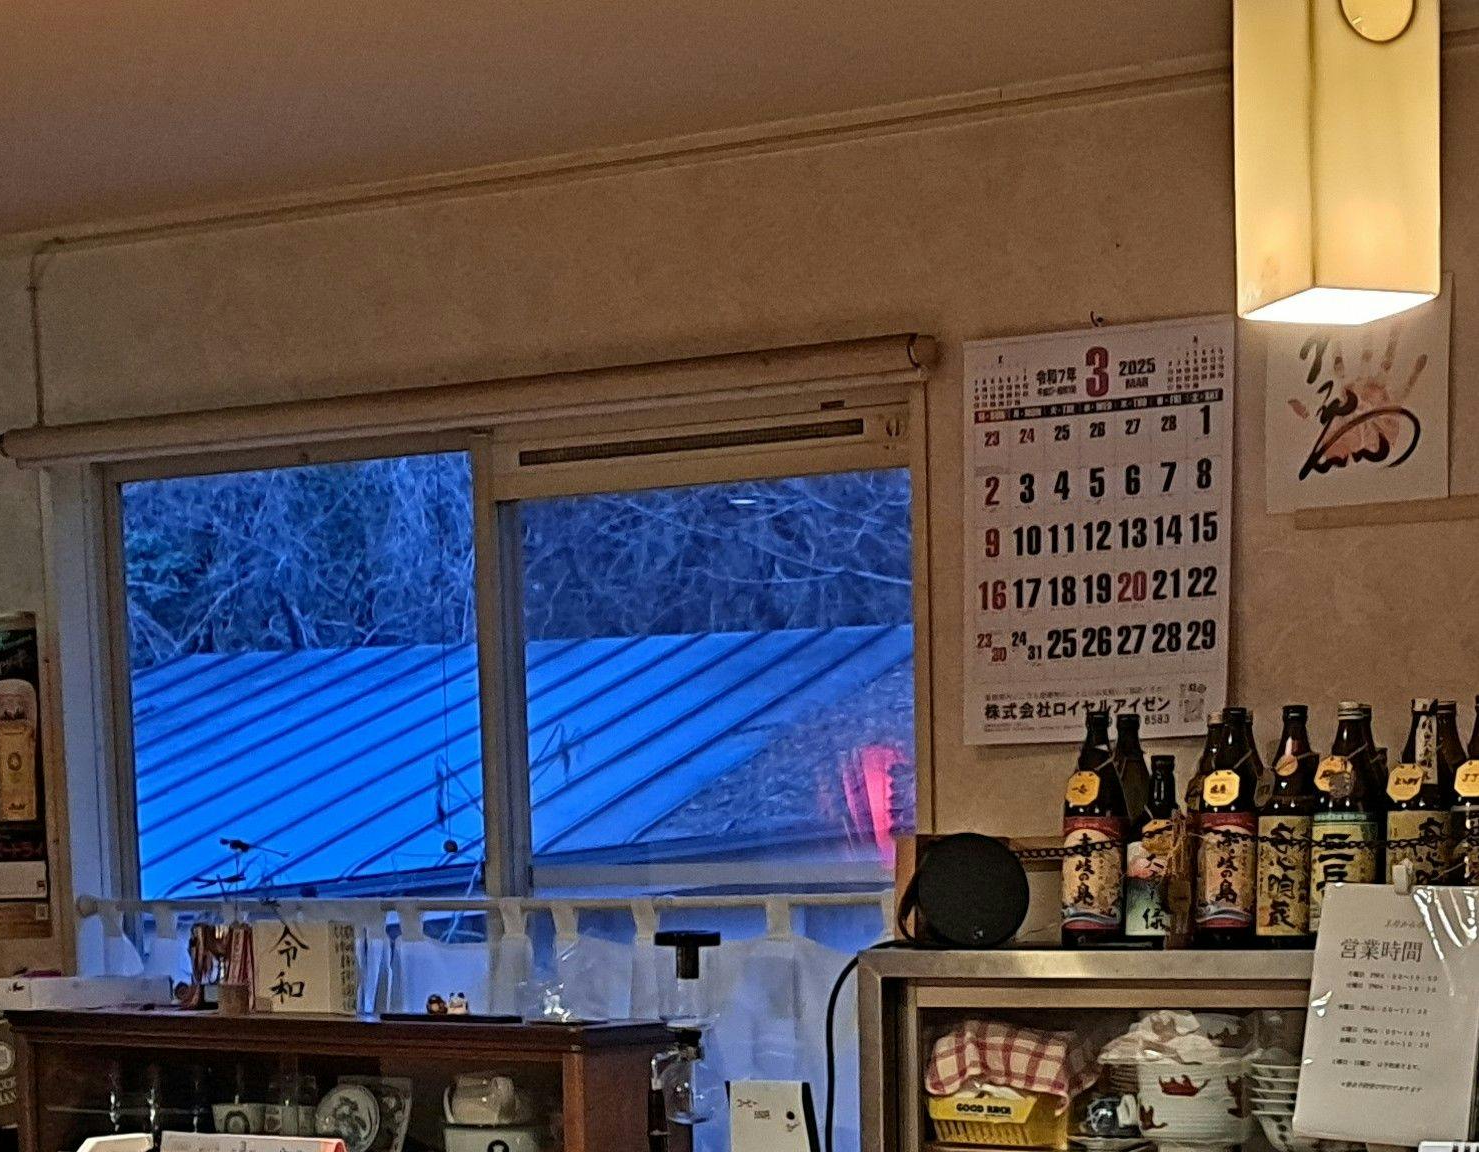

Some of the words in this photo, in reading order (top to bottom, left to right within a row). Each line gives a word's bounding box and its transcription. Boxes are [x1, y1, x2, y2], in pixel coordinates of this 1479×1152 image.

[1085, 346, 1110, 397] 3
[1119, 357, 1156, 377] 2025
[1054, 425, 1070, 442] 25
[1125, 418, 1141, 436] 27
[1199, 405, 1210, 435] 1
[984, 476, 1000, 507] 2
[1019, 473, 1035, 504] 3
[1053, 470, 1070, 501] 4
[1088, 467, 1105, 498] 5
[1125, 464, 1141, 496] 6
[1160, 461, 1177, 492] 7
[1196, 457, 1212, 490] 8
[984, 528, 1000, 559] 9
[1012, 525, 1042, 557] 10
[1047, 522, 1076, 554] 11
[1082, 520, 1113, 552] 12
[1118, 517, 1148, 549] 13
[1153, 514, 1183, 546] 14
[1189, 511, 1219, 544] 15
[978, 580, 1007, 611] 16
[1012, 577, 1042, 609] 17
[1047, 575, 1077, 607] 18
[1082, 573, 1113, 605] 19
[1117, 570, 1148, 602] 20
[1152, 568, 1182, 600] 21
[1187, 566, 1218, 598] 22
[977, 633, 993, 649] 23
[1011, 631, 1027, 647] 24
[1027, 645, 1043, 661] 31
[1047, 628, 1077, 659] 25
[1082, 625, 1112, 658] 26
[1117, 624, 1147, 655] 27
[1151, 621, 1181, 654] 28
[1187, 619, 1217, 651] 29
[984, 697, 1171, 721] 株式会社ロイヤルアイゼン
[271, 923, 310, 1004] 令和
[1340, 938, 1424, 963] 営業時間
[956, 1102, 984, 1113] GOOD
